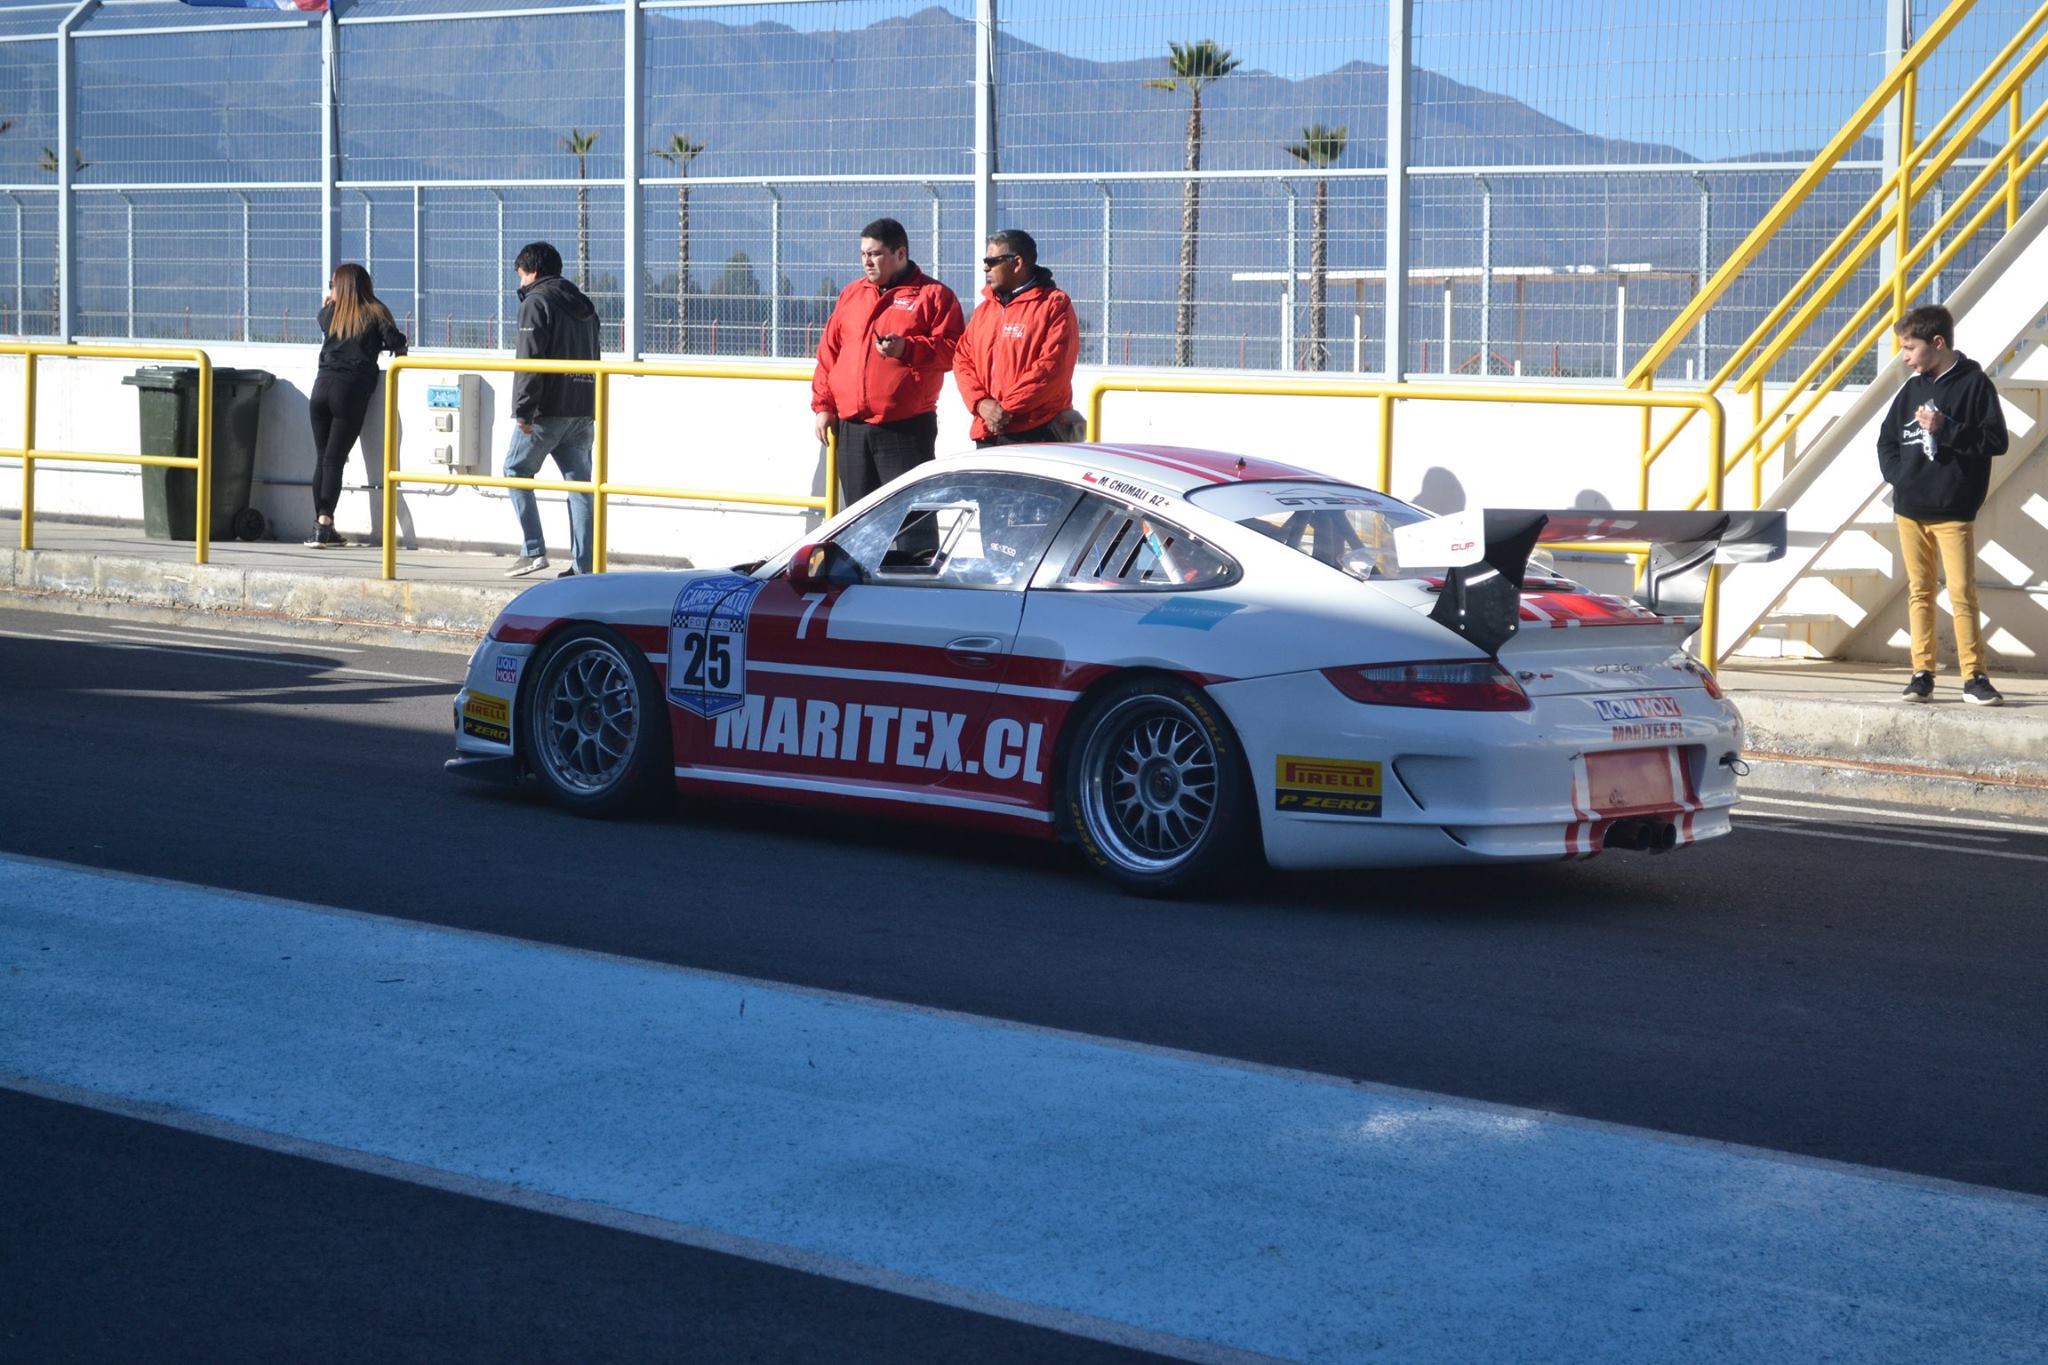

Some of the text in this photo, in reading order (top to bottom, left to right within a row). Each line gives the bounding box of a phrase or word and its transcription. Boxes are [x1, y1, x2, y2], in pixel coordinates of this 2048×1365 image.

[1098, 476, 1109, 487] M.
[1109, 479, 1149, 501] CHOMALI
[1451, 541, 1475, 552] CUP
[681, 588, 749, 612] CAMPEONATO
[796, 592, 828, 640] 7
[497, 656, 517, 670] LIQUI
[683, 631, 731, 690] 25
[496, 670, 517, 683] MOLY
[1595, 697, 1681, 720] LIQUI MOLY
[714, 694, 1044, 785] MARITEX.CL
[1286, 762, 1375, 788] PIRELLI
[1280, 795, 1377, 811] P ZERO
